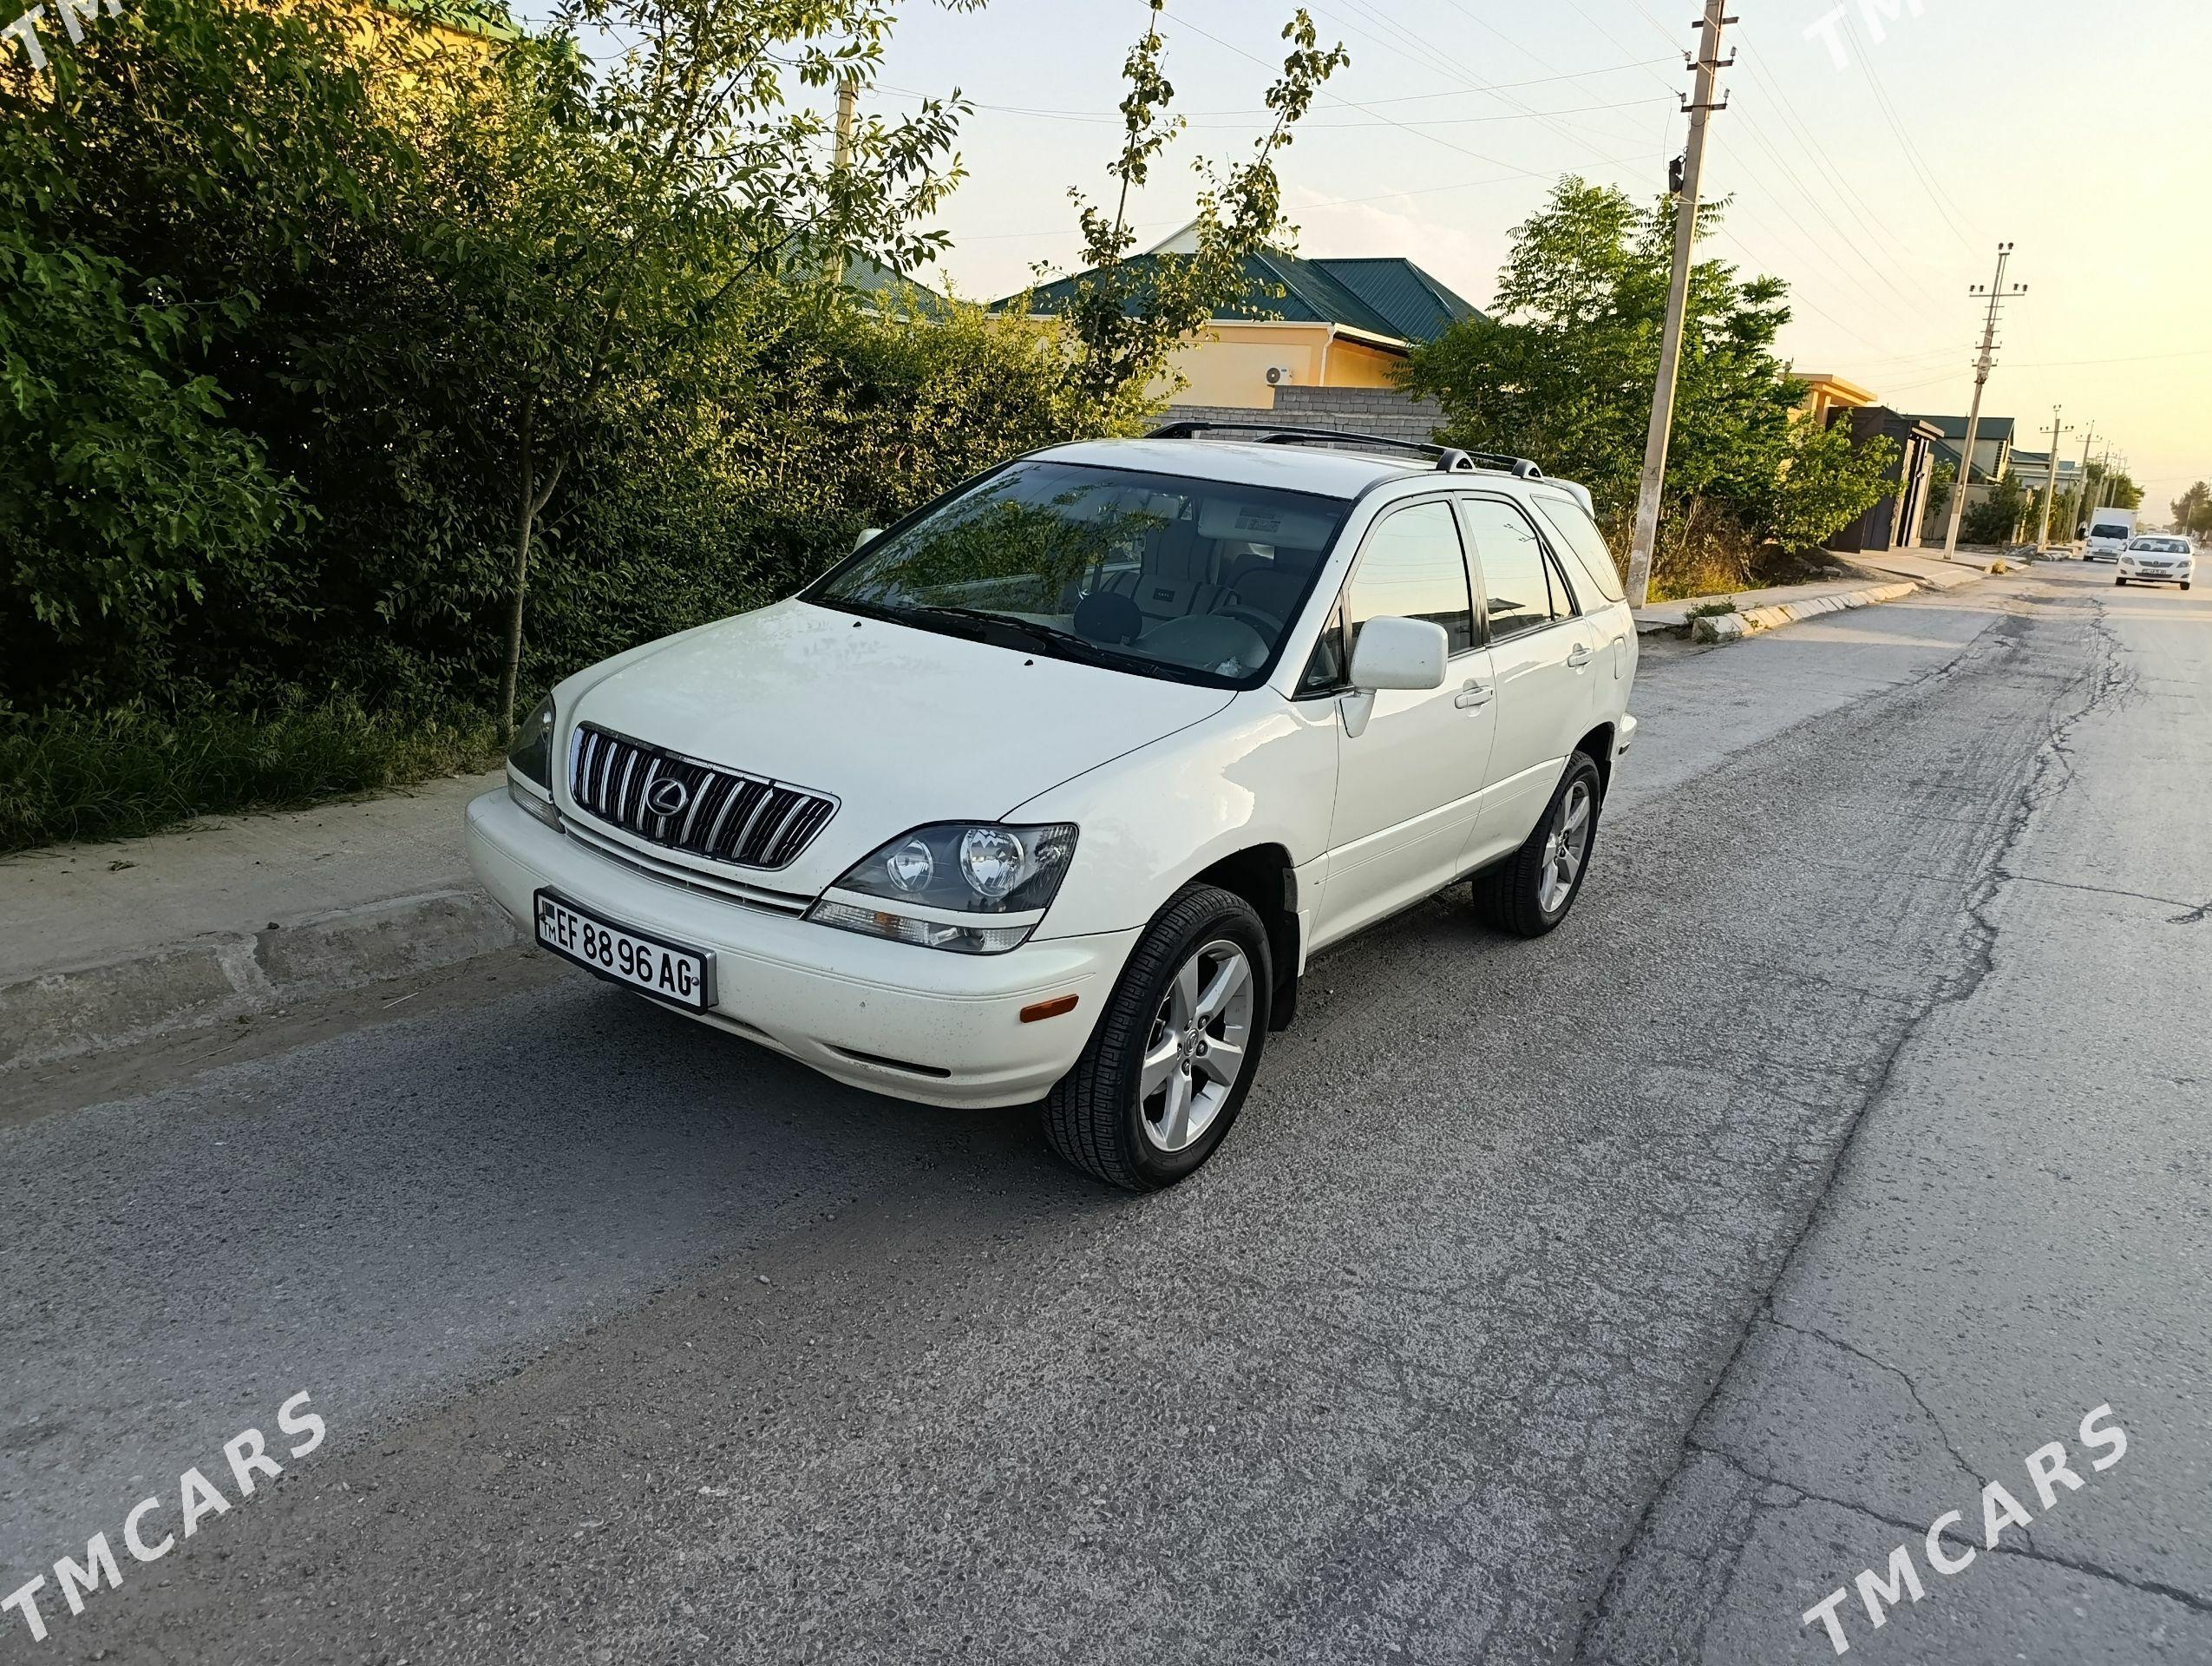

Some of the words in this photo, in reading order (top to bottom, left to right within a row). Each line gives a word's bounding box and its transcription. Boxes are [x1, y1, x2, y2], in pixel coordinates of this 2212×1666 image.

[543, 921, 556, 942] TM
[558, 908, 578, 950] EF
[658, 953, 692, 997] AG
